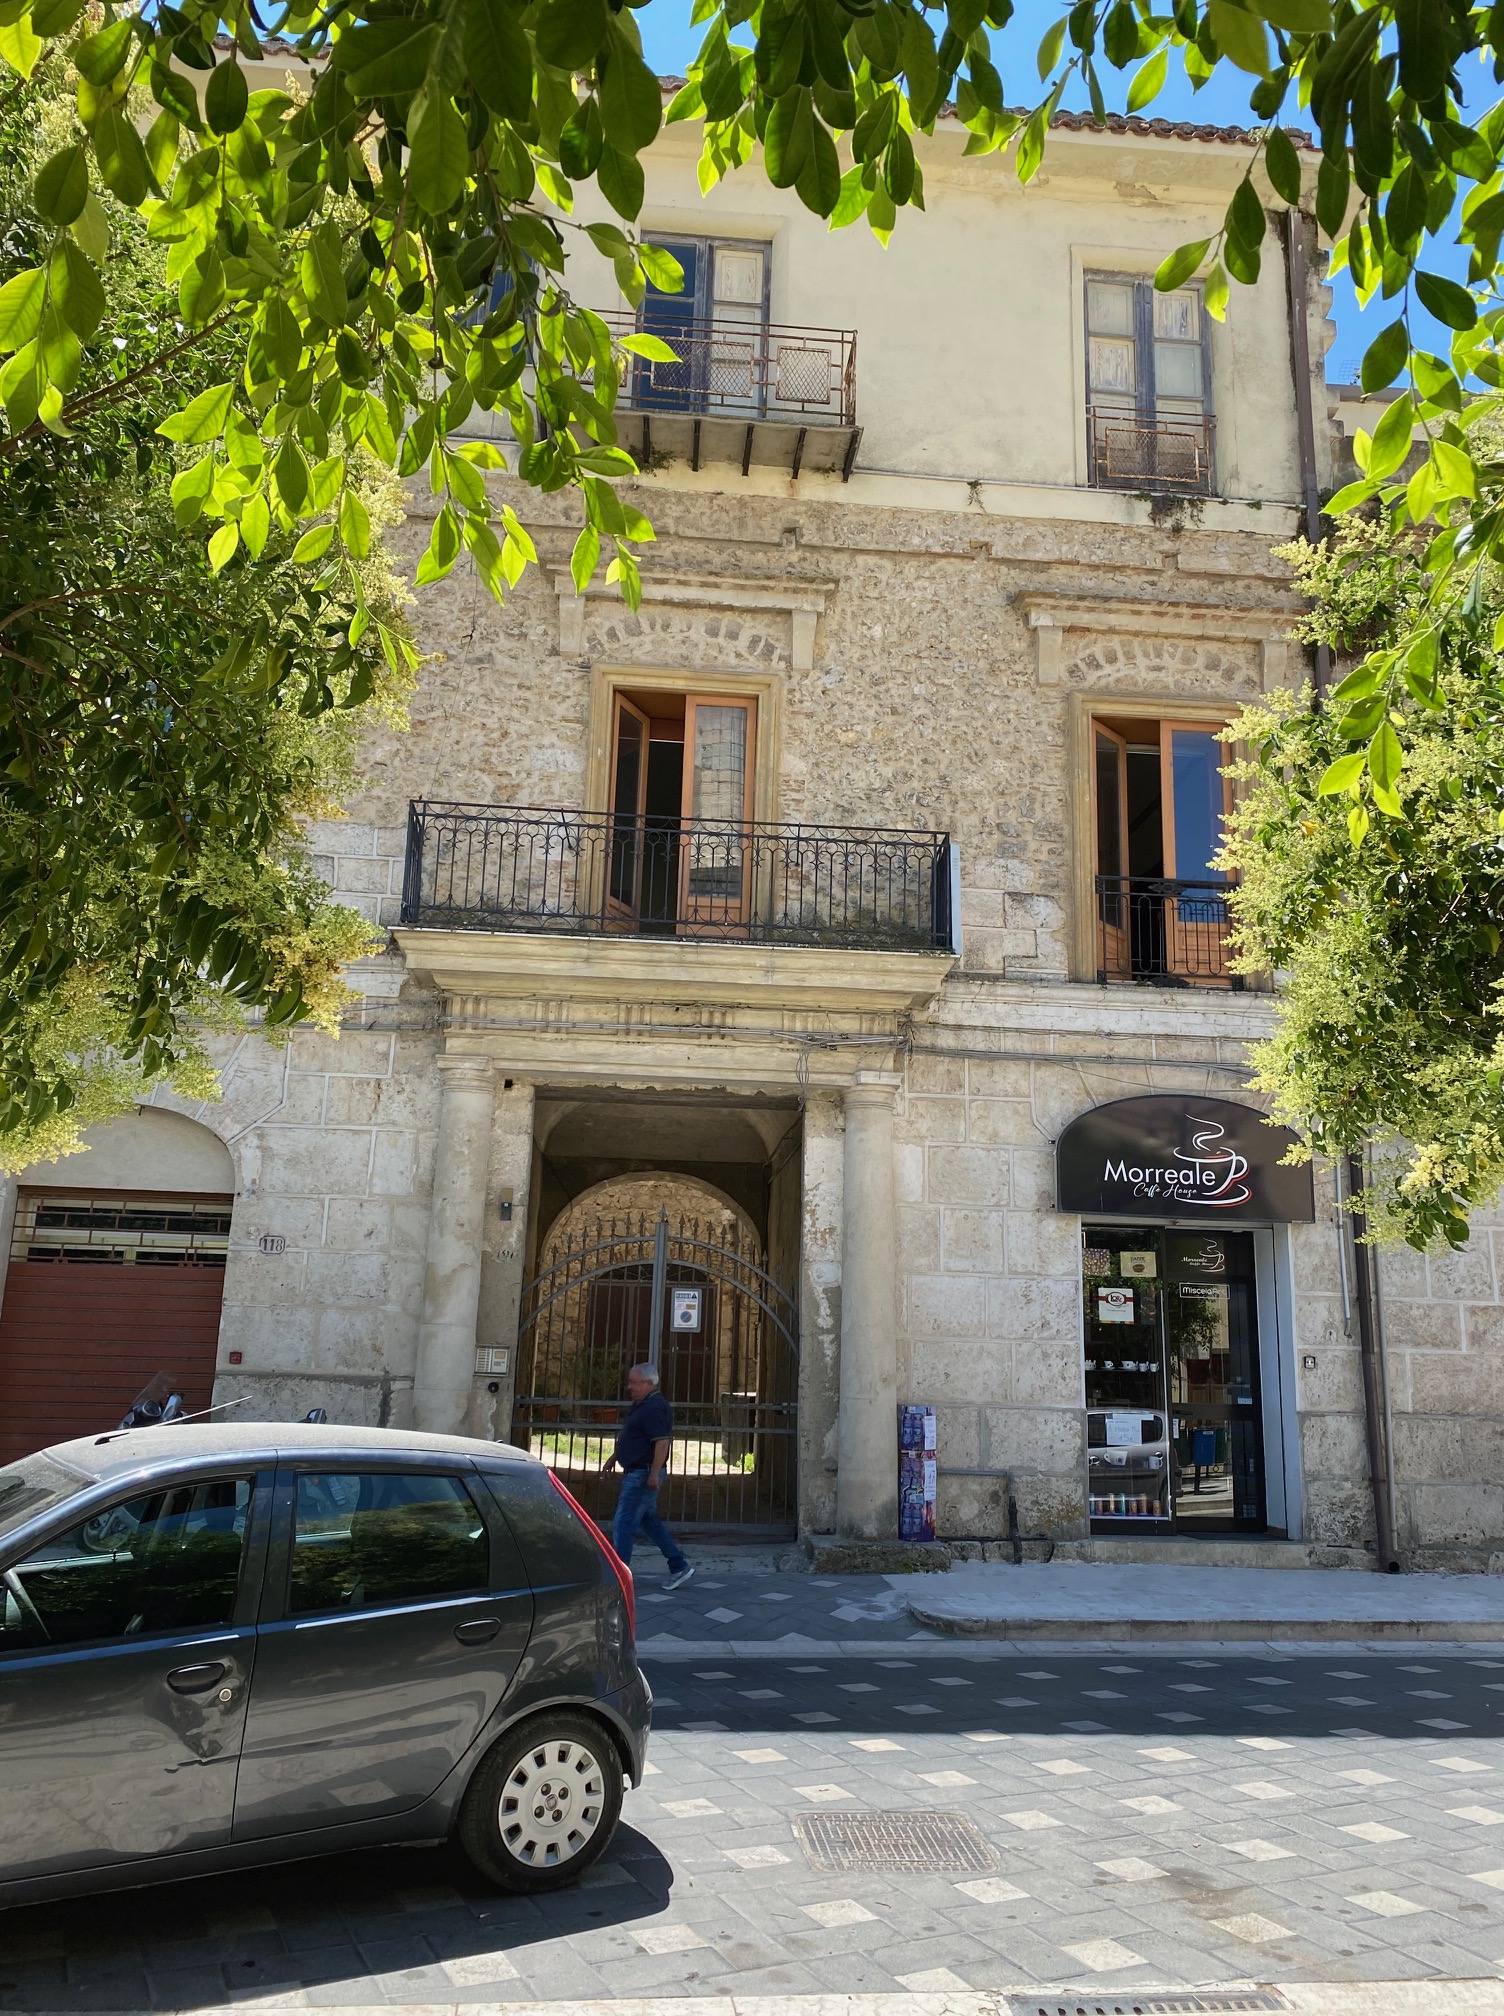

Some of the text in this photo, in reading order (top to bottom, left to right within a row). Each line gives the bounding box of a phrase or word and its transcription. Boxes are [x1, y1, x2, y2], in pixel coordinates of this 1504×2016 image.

[1104, 1159, 1216, 1185] Morreale
[1162, 1183, 1198, 1199] House
[263, 1239, 283, 1251] 118
